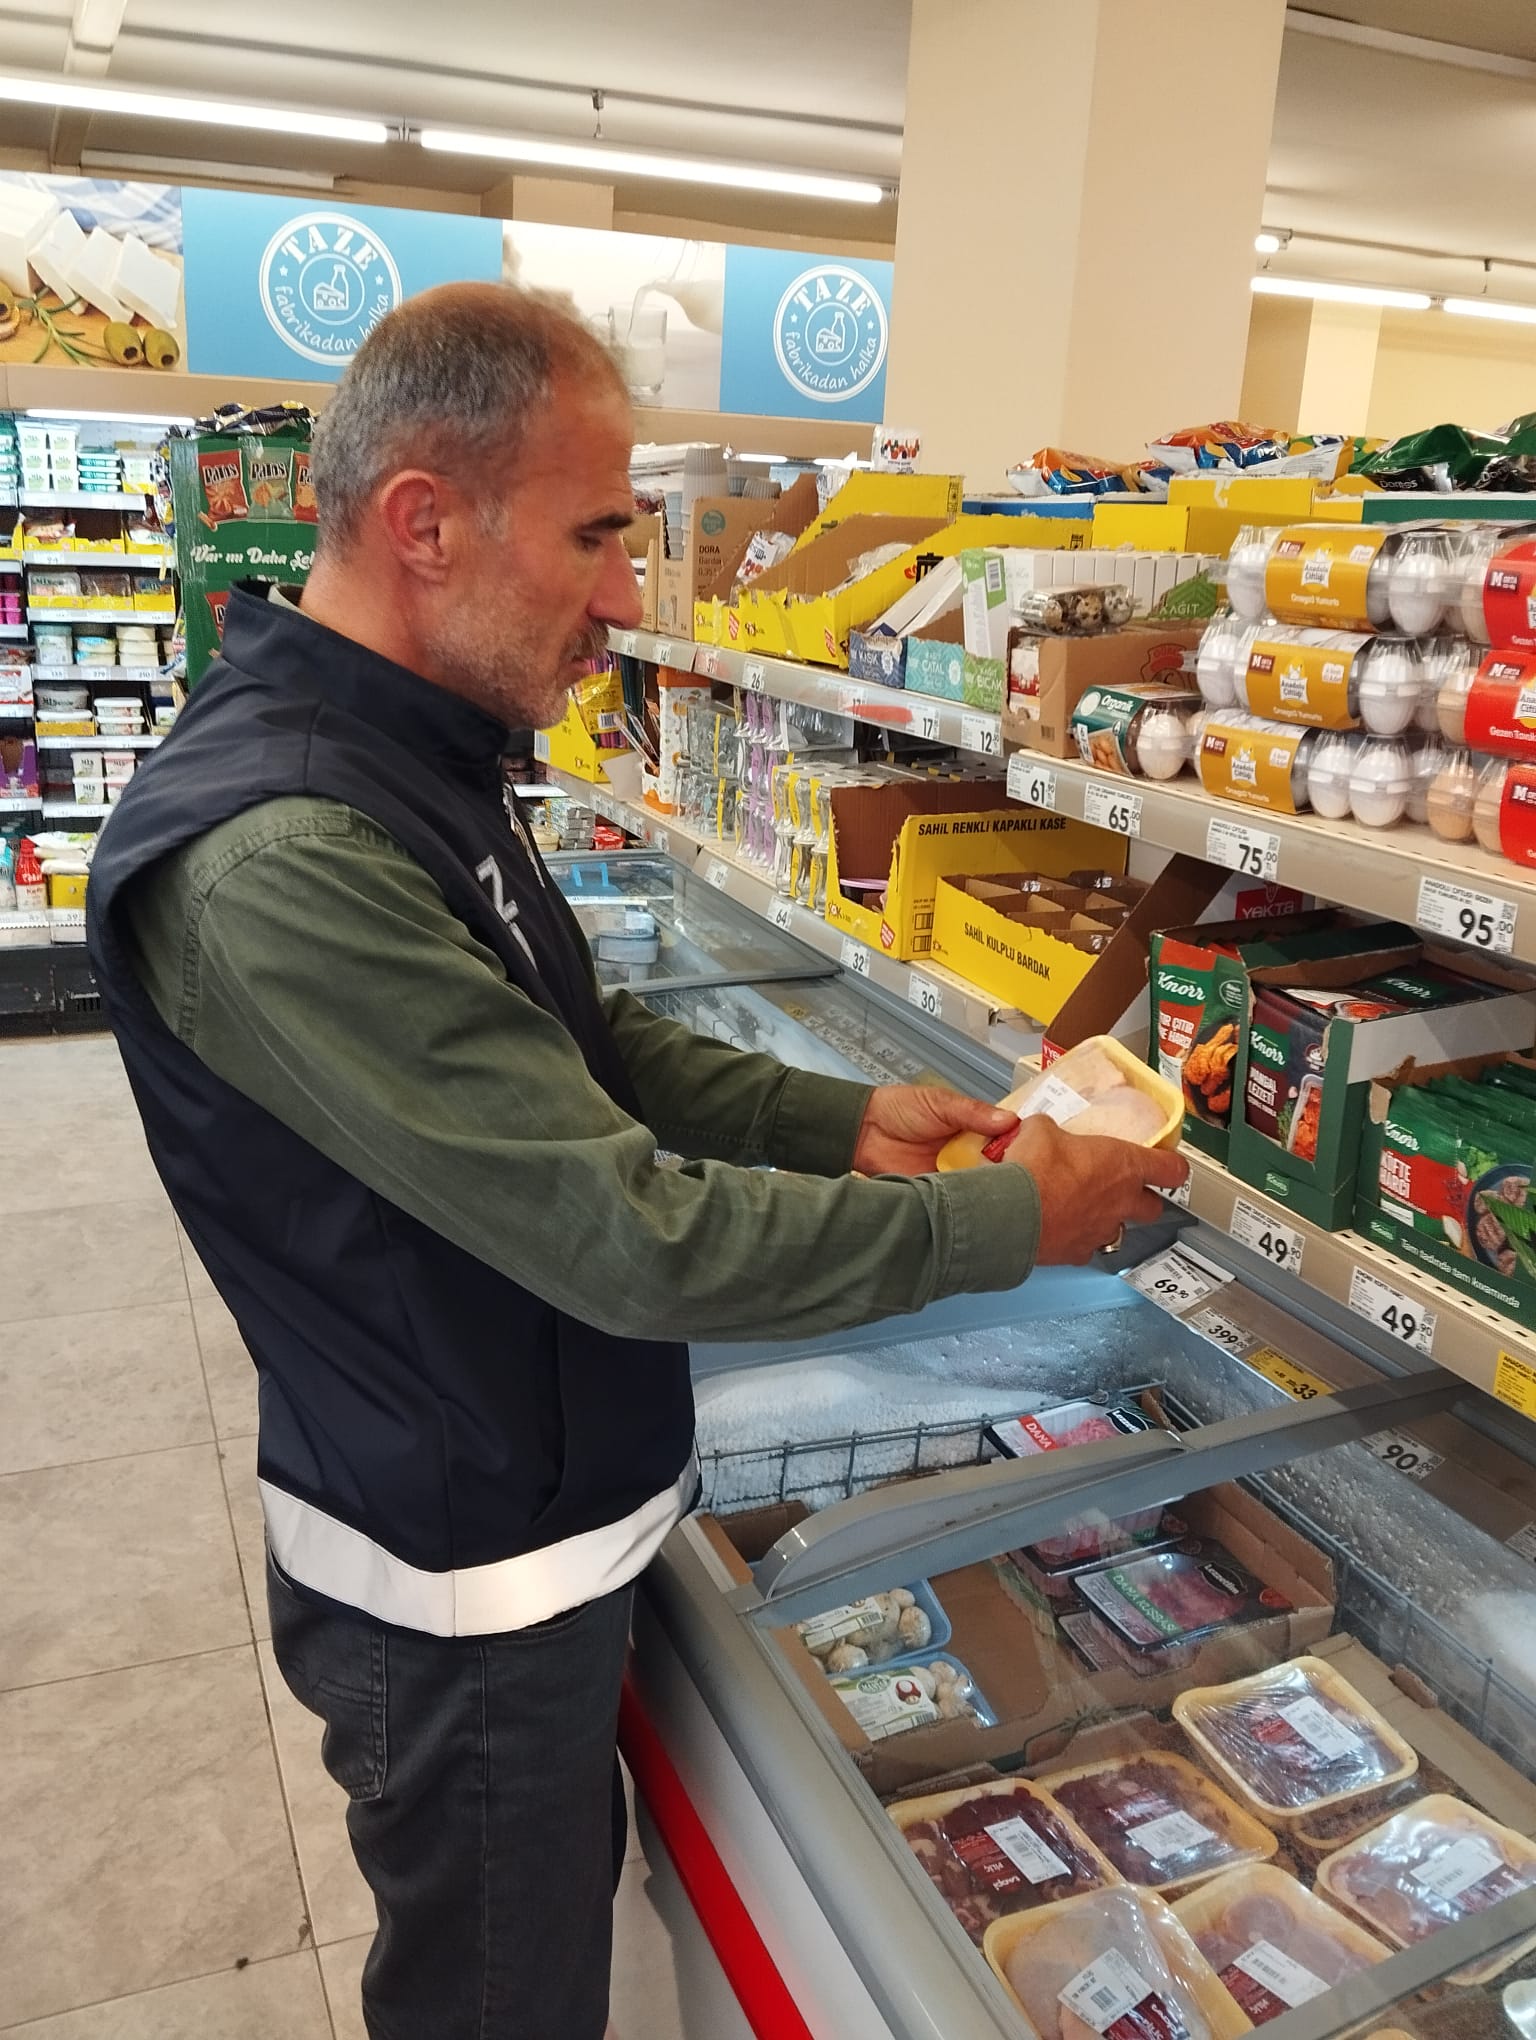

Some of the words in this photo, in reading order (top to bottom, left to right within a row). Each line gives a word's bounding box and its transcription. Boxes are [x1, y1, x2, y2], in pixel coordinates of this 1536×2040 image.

[281, 224, 379, 272] TAZE
[793, 275, 872, 317] TAZE
[274, 285, 359, 351] fabrikadan
[785, 331, 849, 389] fabrikadan
[850, 336, 878, 380] halka
[247, 547, 288, 566] Daha
[699, 545, 721, 554] DORA
[751, 672, 762, 690] 26
[1100, 694, 1135, 713] Organik
[922, 717, 934, 738] 17
[980, 730, 993, 753] 12
[1030, 779, 1046, 805] 61
[918, 822, 950, 836] SAHİL
[952, 820, 990, 834] RENKLİ
[992, 818, 1038, 832] KAPAKLI
[1039, 816, 1068, 831] KASE
[1108, 804, 1130, 832] 65
[1238, 843, 1263, 875] 75
[776, 909, 787, 926] 64
[1459, 908, 1495, 946] 95
[852, 952, 865, 973] 32
[1016, 952, 1051, 982] BARDAK
[1157, 970, 1207, 1002] Knorr
[920, 990, 936, 1013] 30
[1249, 1030, 1287, 1066] Knorr
[1383, 1119, 1421, 1151] Knorr
[1258, 1231, 1289, 1264] 49
[1401, 1238, 1419, 1256] Tam
[1451, 1266, 1472, 1285] tam
[1154, 1278, 1178, 1295] 69
[1207, 1324, 1239, 1345] 399
[1381, 1304, 1417, 1341] 49
[1292, 1383, 1319, 1401] 33
[1025, 1421, 1053, 1450] DANA
[1382, 1444, 1420, 1471] 90
[1112, 1573, 1141, 1602] DANA
